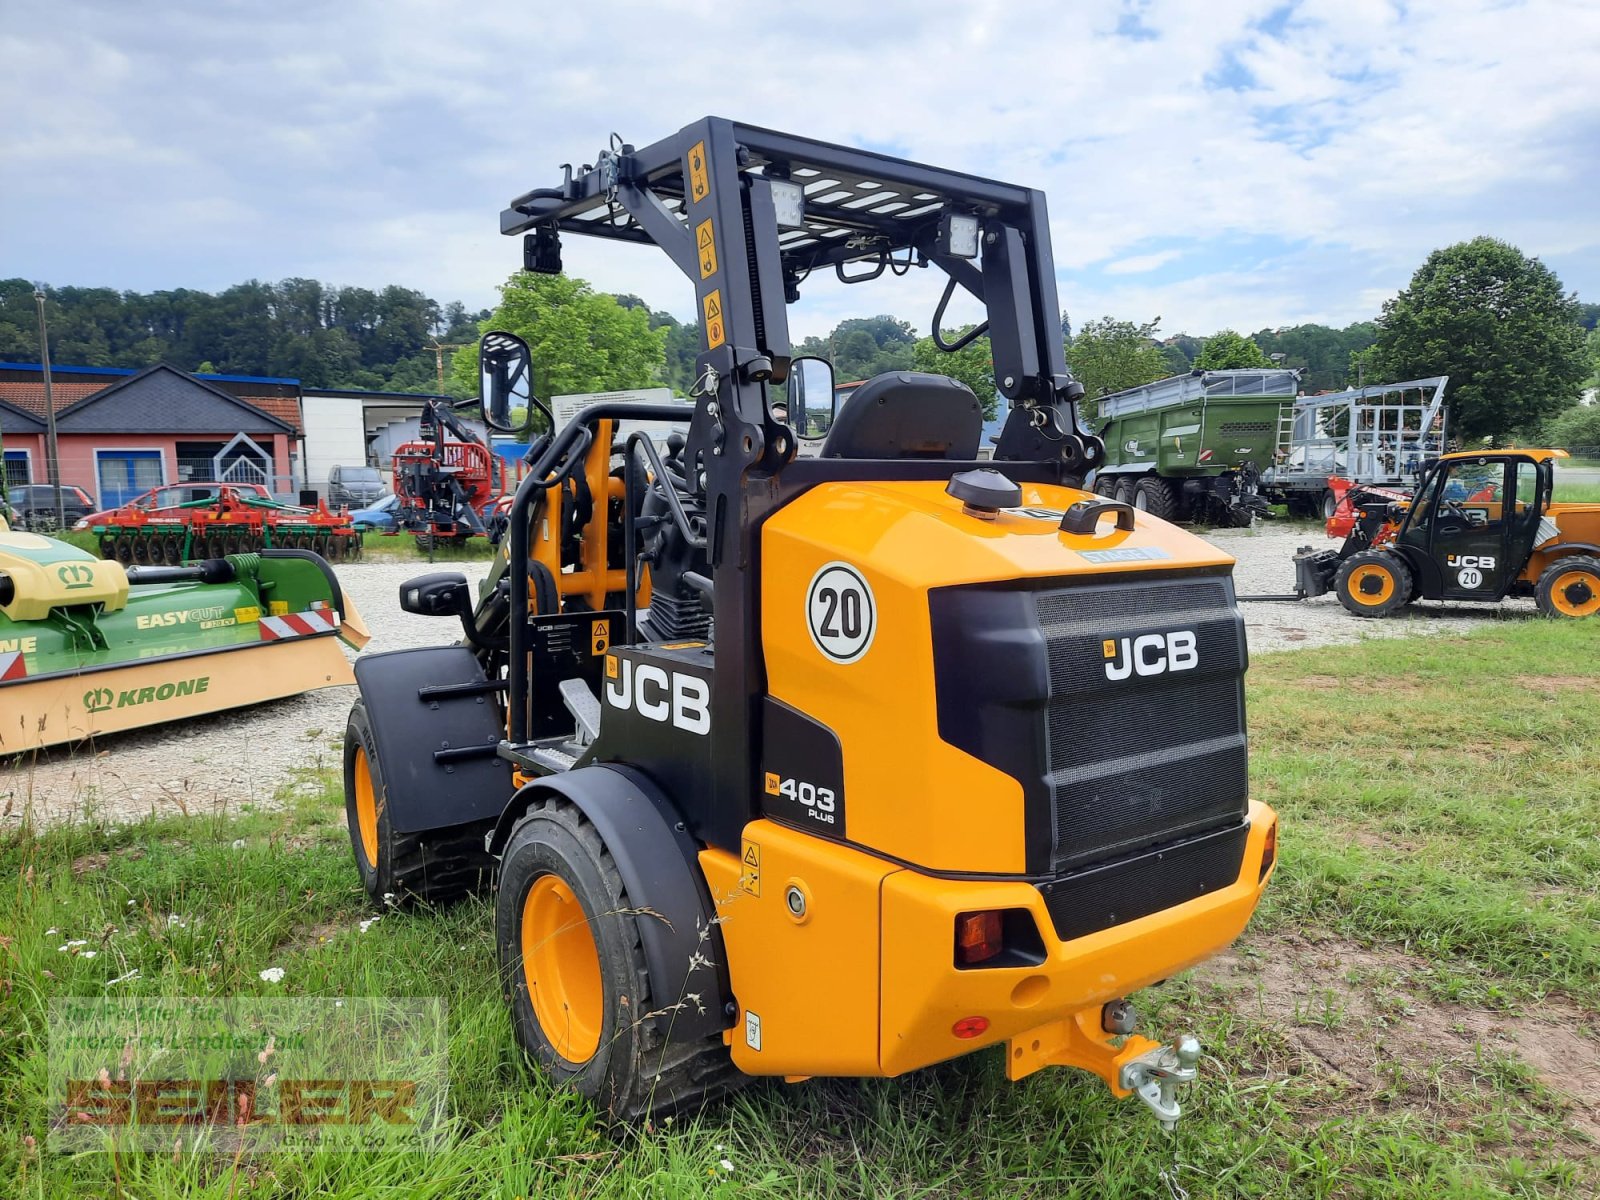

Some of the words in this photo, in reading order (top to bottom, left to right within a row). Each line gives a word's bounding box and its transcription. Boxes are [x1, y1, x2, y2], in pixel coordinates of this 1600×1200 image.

[1447, 555, 1496, 568] JCB
[1463, 572, 1477, 584] 20
[818, 587, 862, 639] 20
[1104, 630, 1199, 681] JCB
[116, 676, 210, 708] KRONE
[606, 658, 711, 736] JCB
[779, 778, 835, 813] 403
[808, 808, 835, 824] PLUS
